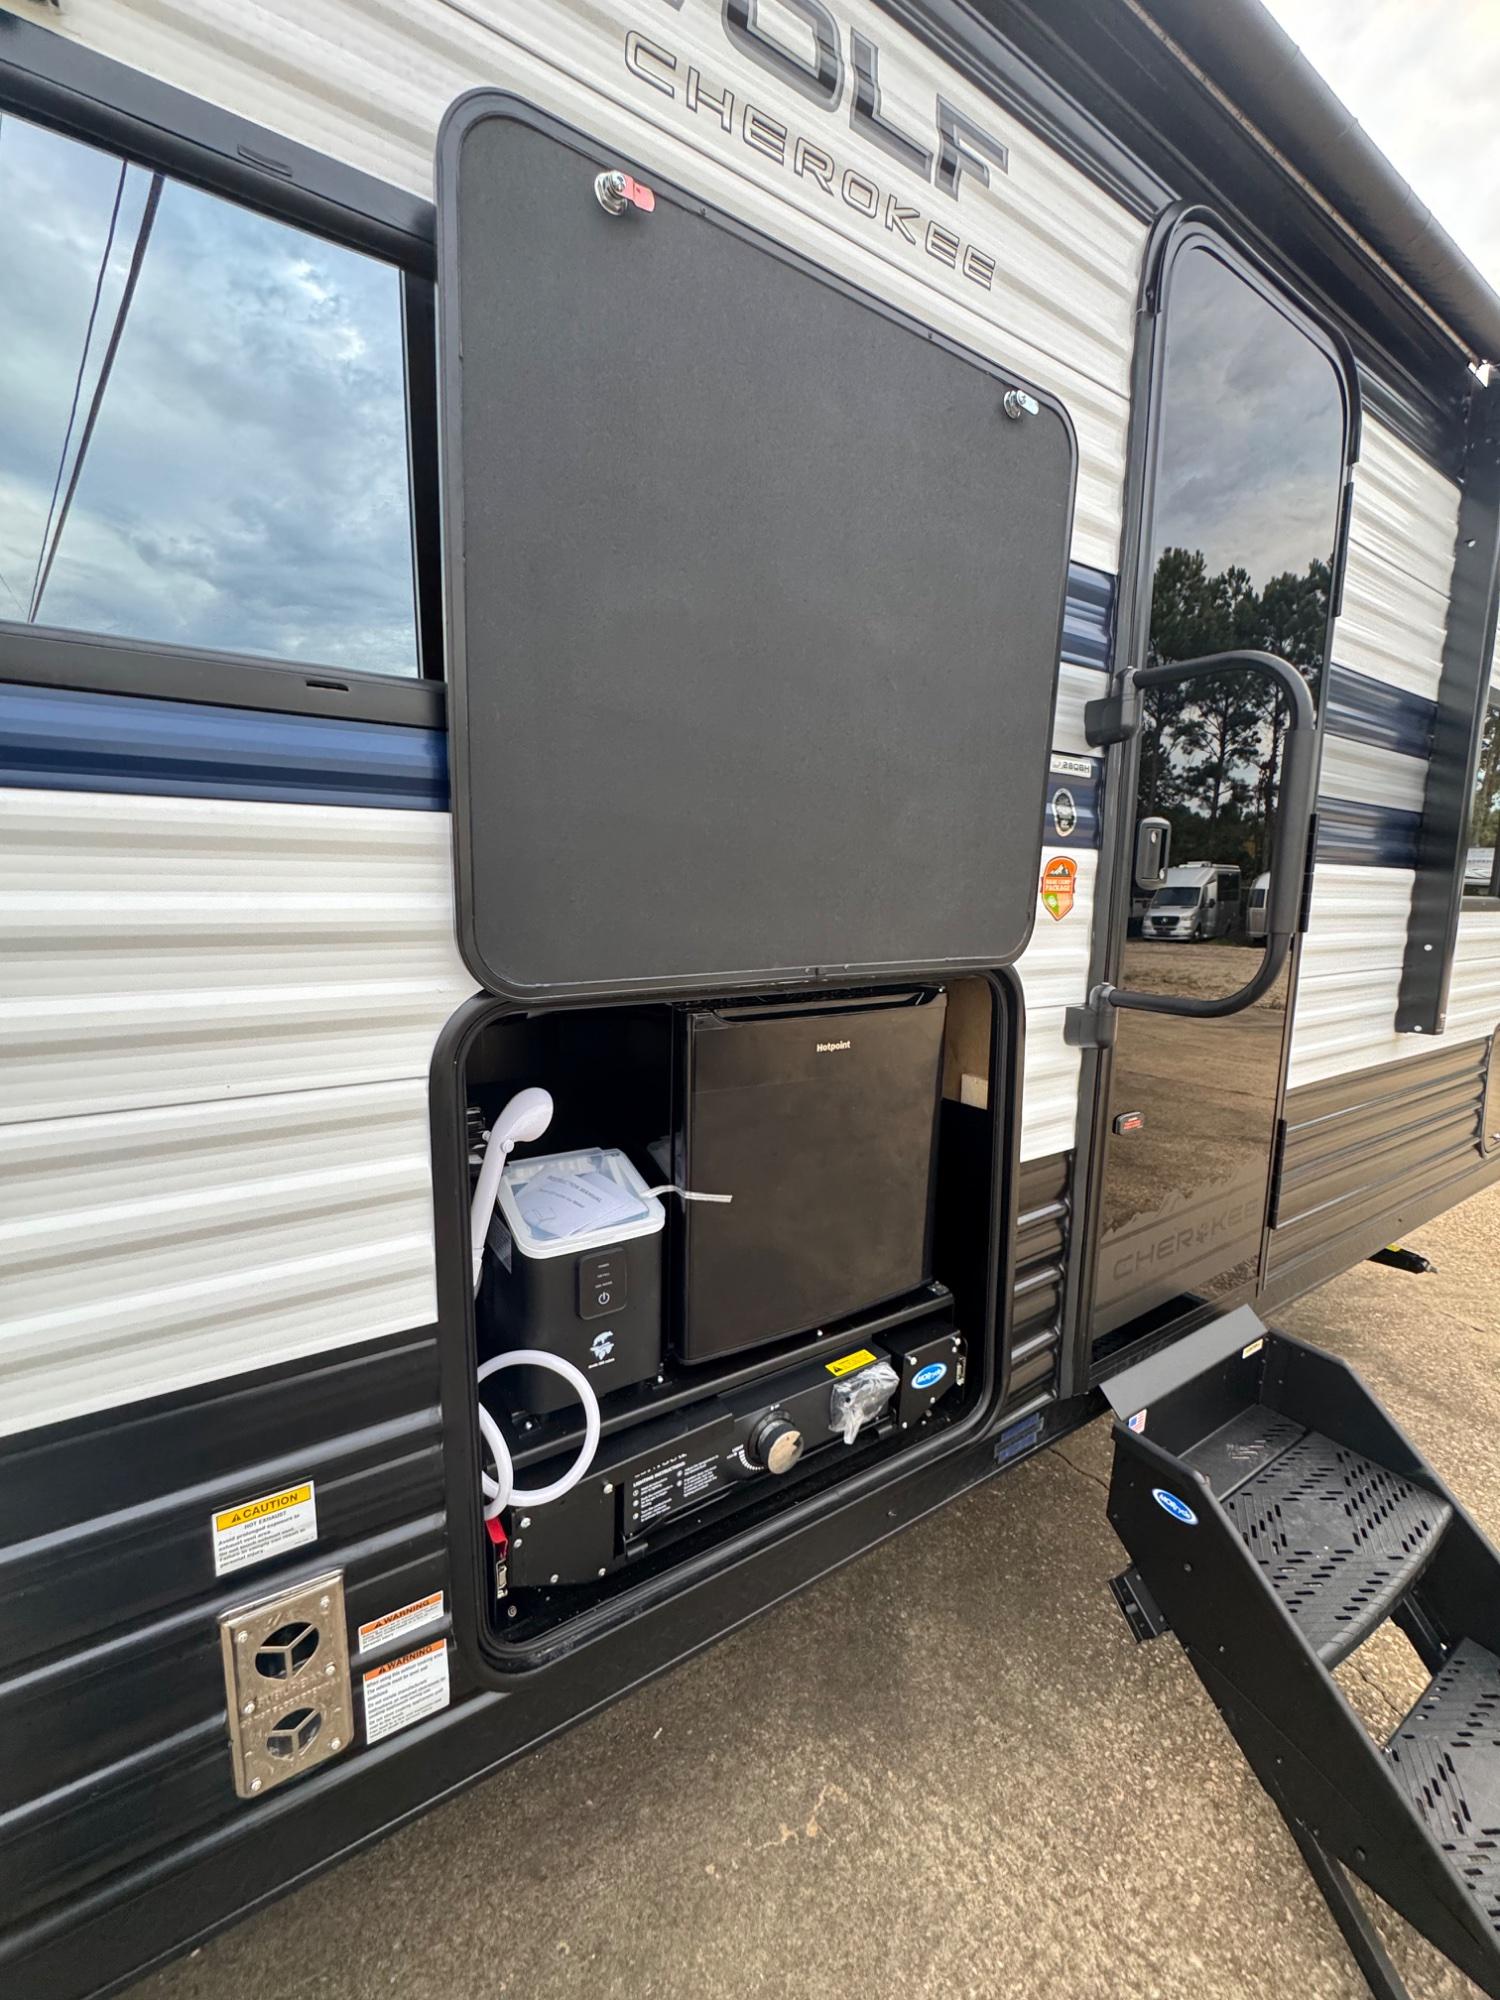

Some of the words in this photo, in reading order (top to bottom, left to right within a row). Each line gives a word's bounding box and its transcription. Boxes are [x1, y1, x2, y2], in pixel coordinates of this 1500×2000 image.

[625, 30, 996, 290] CHEROKEE
[816, 1040, 851, 1052] Hotpoint
[243, 1492, 297, 1518] CAUTION
[384, 1599, 429, 1624] WARNING
[387, 1645, 432, 1670] WARNING
